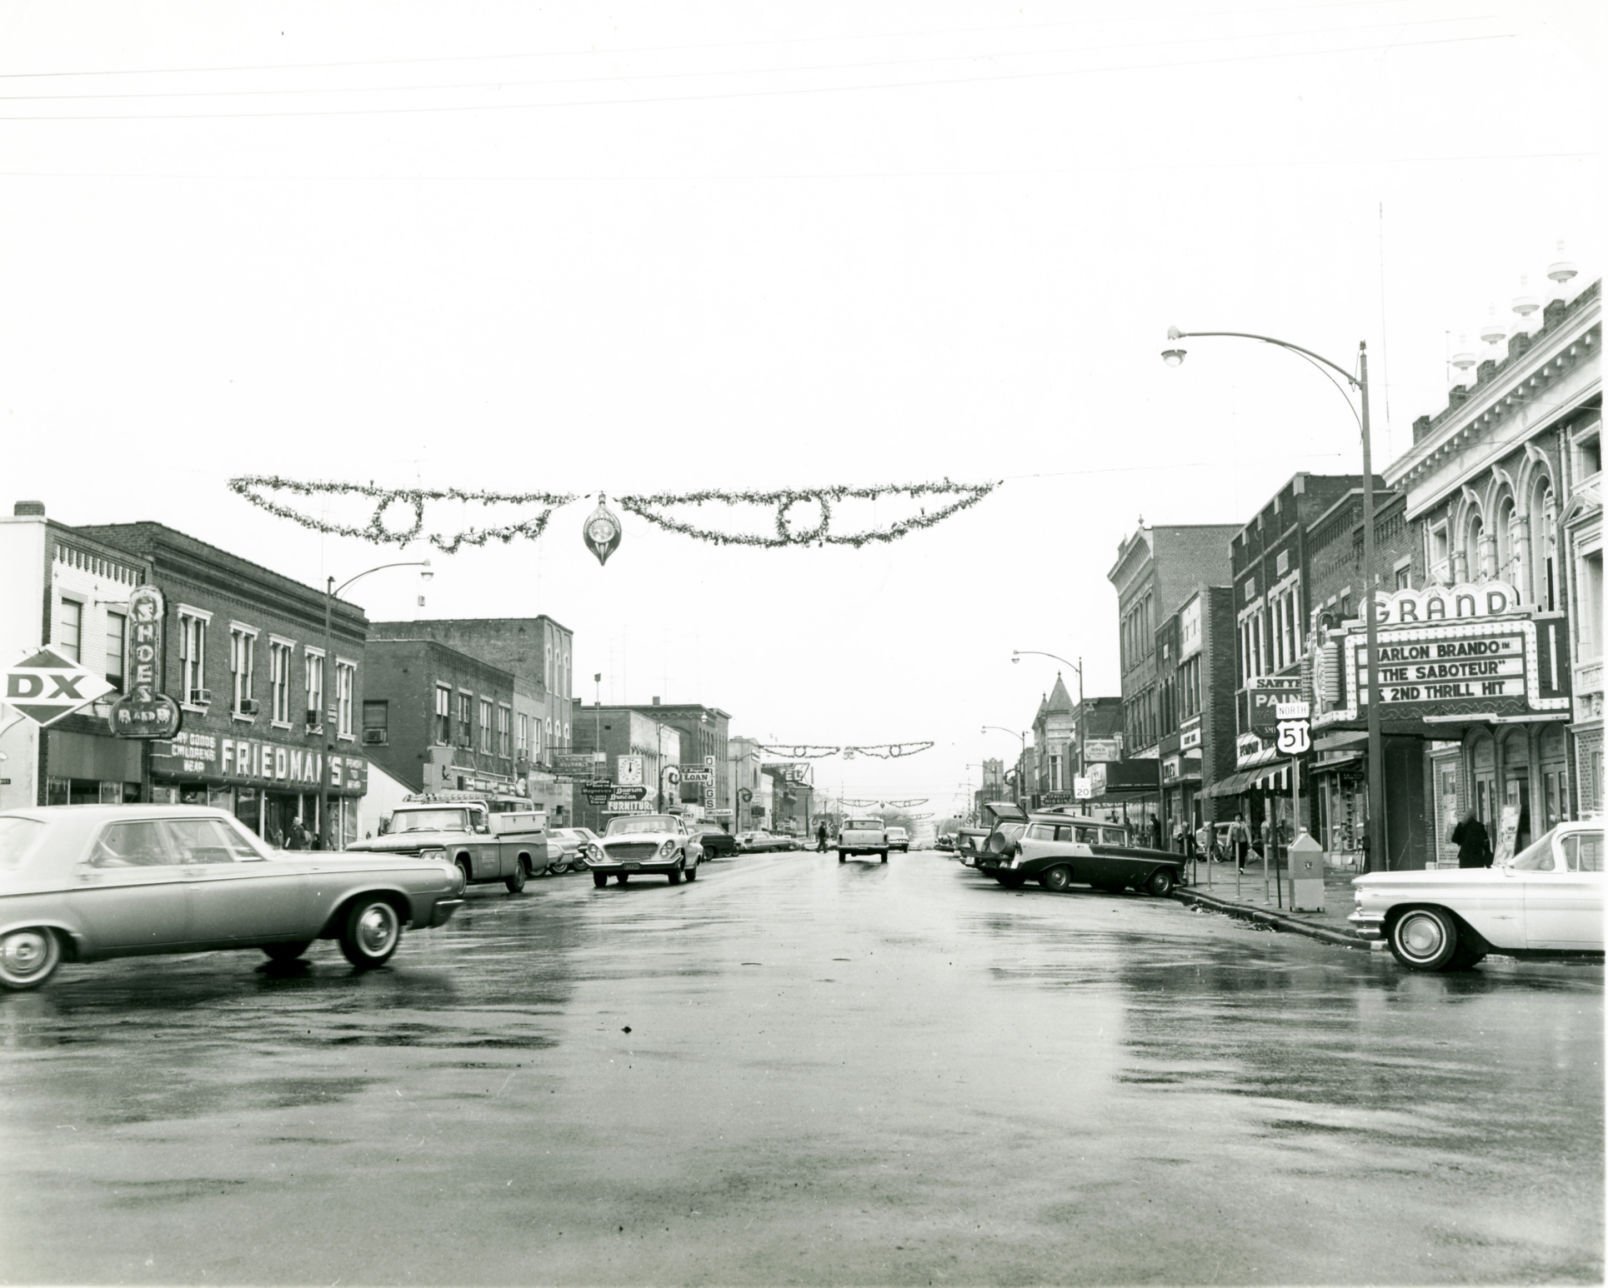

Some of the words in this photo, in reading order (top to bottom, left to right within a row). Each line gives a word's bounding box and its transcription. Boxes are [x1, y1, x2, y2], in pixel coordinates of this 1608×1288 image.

[1374, 591, 1508, 625] GRAND
[136, 603, 154, 702] SHOES
[1378, 645, 1430, 662] ARLON
[1437, 641, 1500, 657] BRANDO
[1416, 660, 1506, 679] SABOTEUR"
[6, 674, 88, 699] DX
[1256, 680, 1303, 689] SAWYE
[1391, 688, 1421, 700] 2ND
[1425, 684, 1475, 698] THRILL
[1482, 681, 1506, 695] HIT
[1255, 694, 1303, 707] PAIN
[1279, 707, 1307, 715] NORTH
[189, 733, 217, 749] GOODS
[1284, 727, 1305, 748] 51
[1076, 788, 1090, 796] 20
